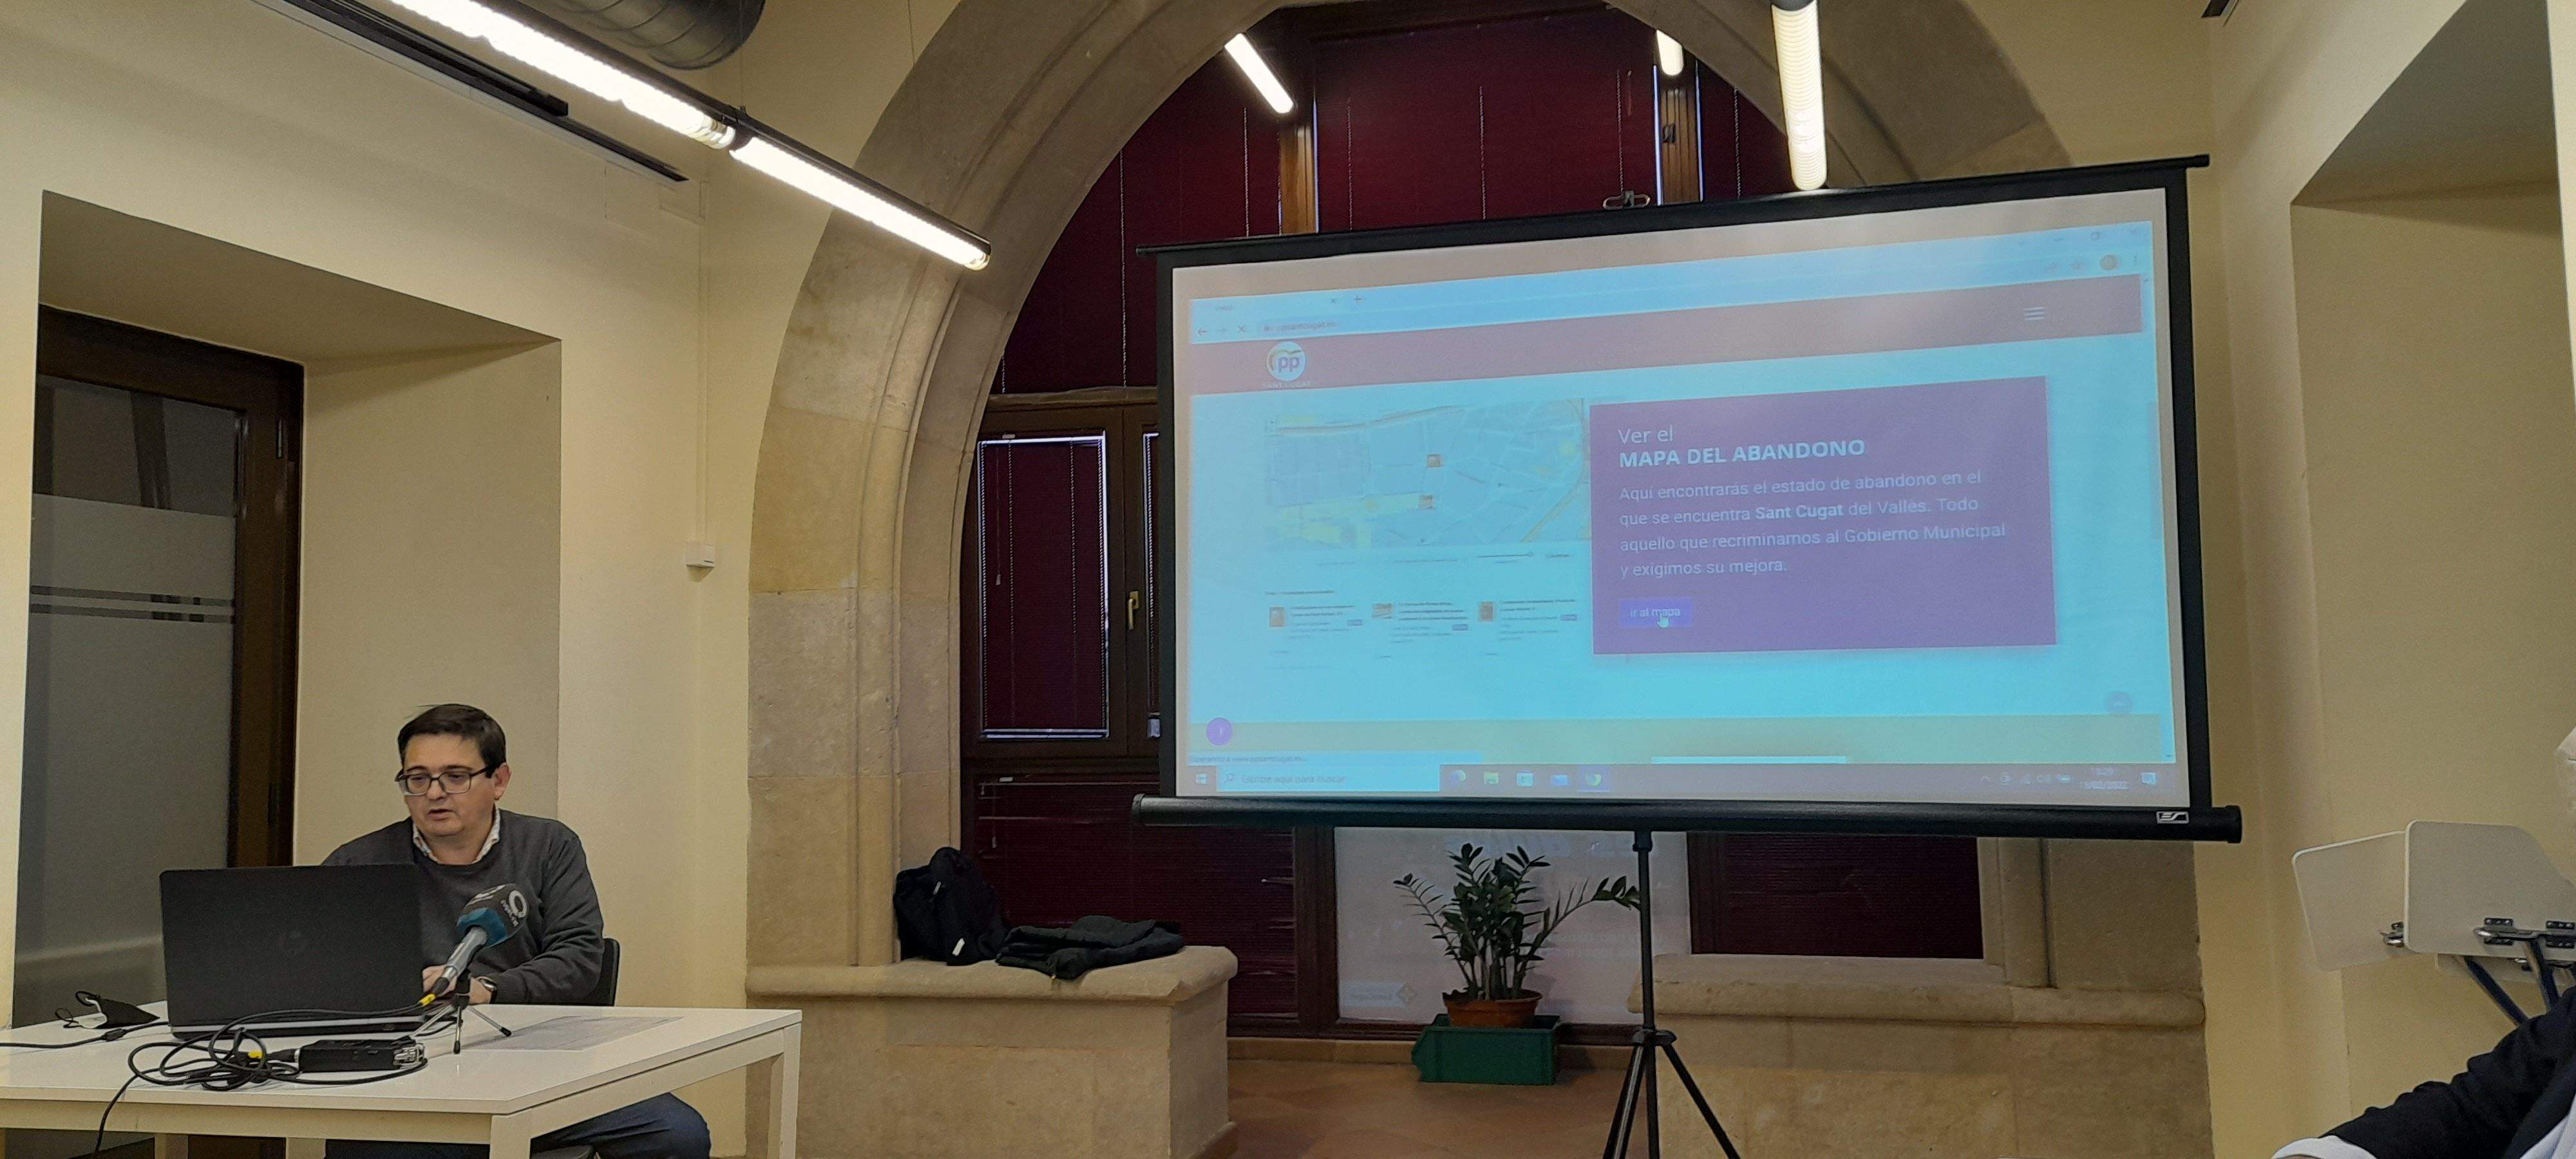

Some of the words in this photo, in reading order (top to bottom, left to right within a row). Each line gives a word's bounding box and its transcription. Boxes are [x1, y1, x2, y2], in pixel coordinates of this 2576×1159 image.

[1618, 428, 1651, 444] Ver
[1657, 424, 1674, 442] el
[1619, 449, 1681, 467] MAPA
[1687, 447, 1726, 464] DEL
[1732, 439, 1865, 462] ABANDONO
[1619, 485, 1653, 502] Aquí
[1754, 480, 1767, 494] el
[1771, 478, 1825, 493] estado
[1830, 477, 1850, 490] de
[1855, 473, 1937, 490] abandono
[1942, 473, 1962, 484] en
[1967, 469, 1982, 484] el
[1620, 514, 1648, 528] que
[1653, 513, 1670, 524] se
[1674, 509, 1750, 523] encuentra
[1755, 507, 1791, 520] Sant
[1795, 504, 1844, 520] Cugat
[1848, 501, 1872, 516] del
[1936, 496, 1979, 511] Todo
[1620, 536, 1674, 554] aquello
[1680, 537, 1709, 552] que
[1712, 532, 1821, 549] recriminamos
[1826, 529, 1839, 543] al
[1844, 527, 1918, 543] Gobierno
[1924, 522, 2005, 541] Municipal
[1620, 567, 1628, 580] y
[1633, 561, 1701, 579] exigimos
[1707, 563, 1724, 574] su
[1730, 558, 1788, 576] mejora.
